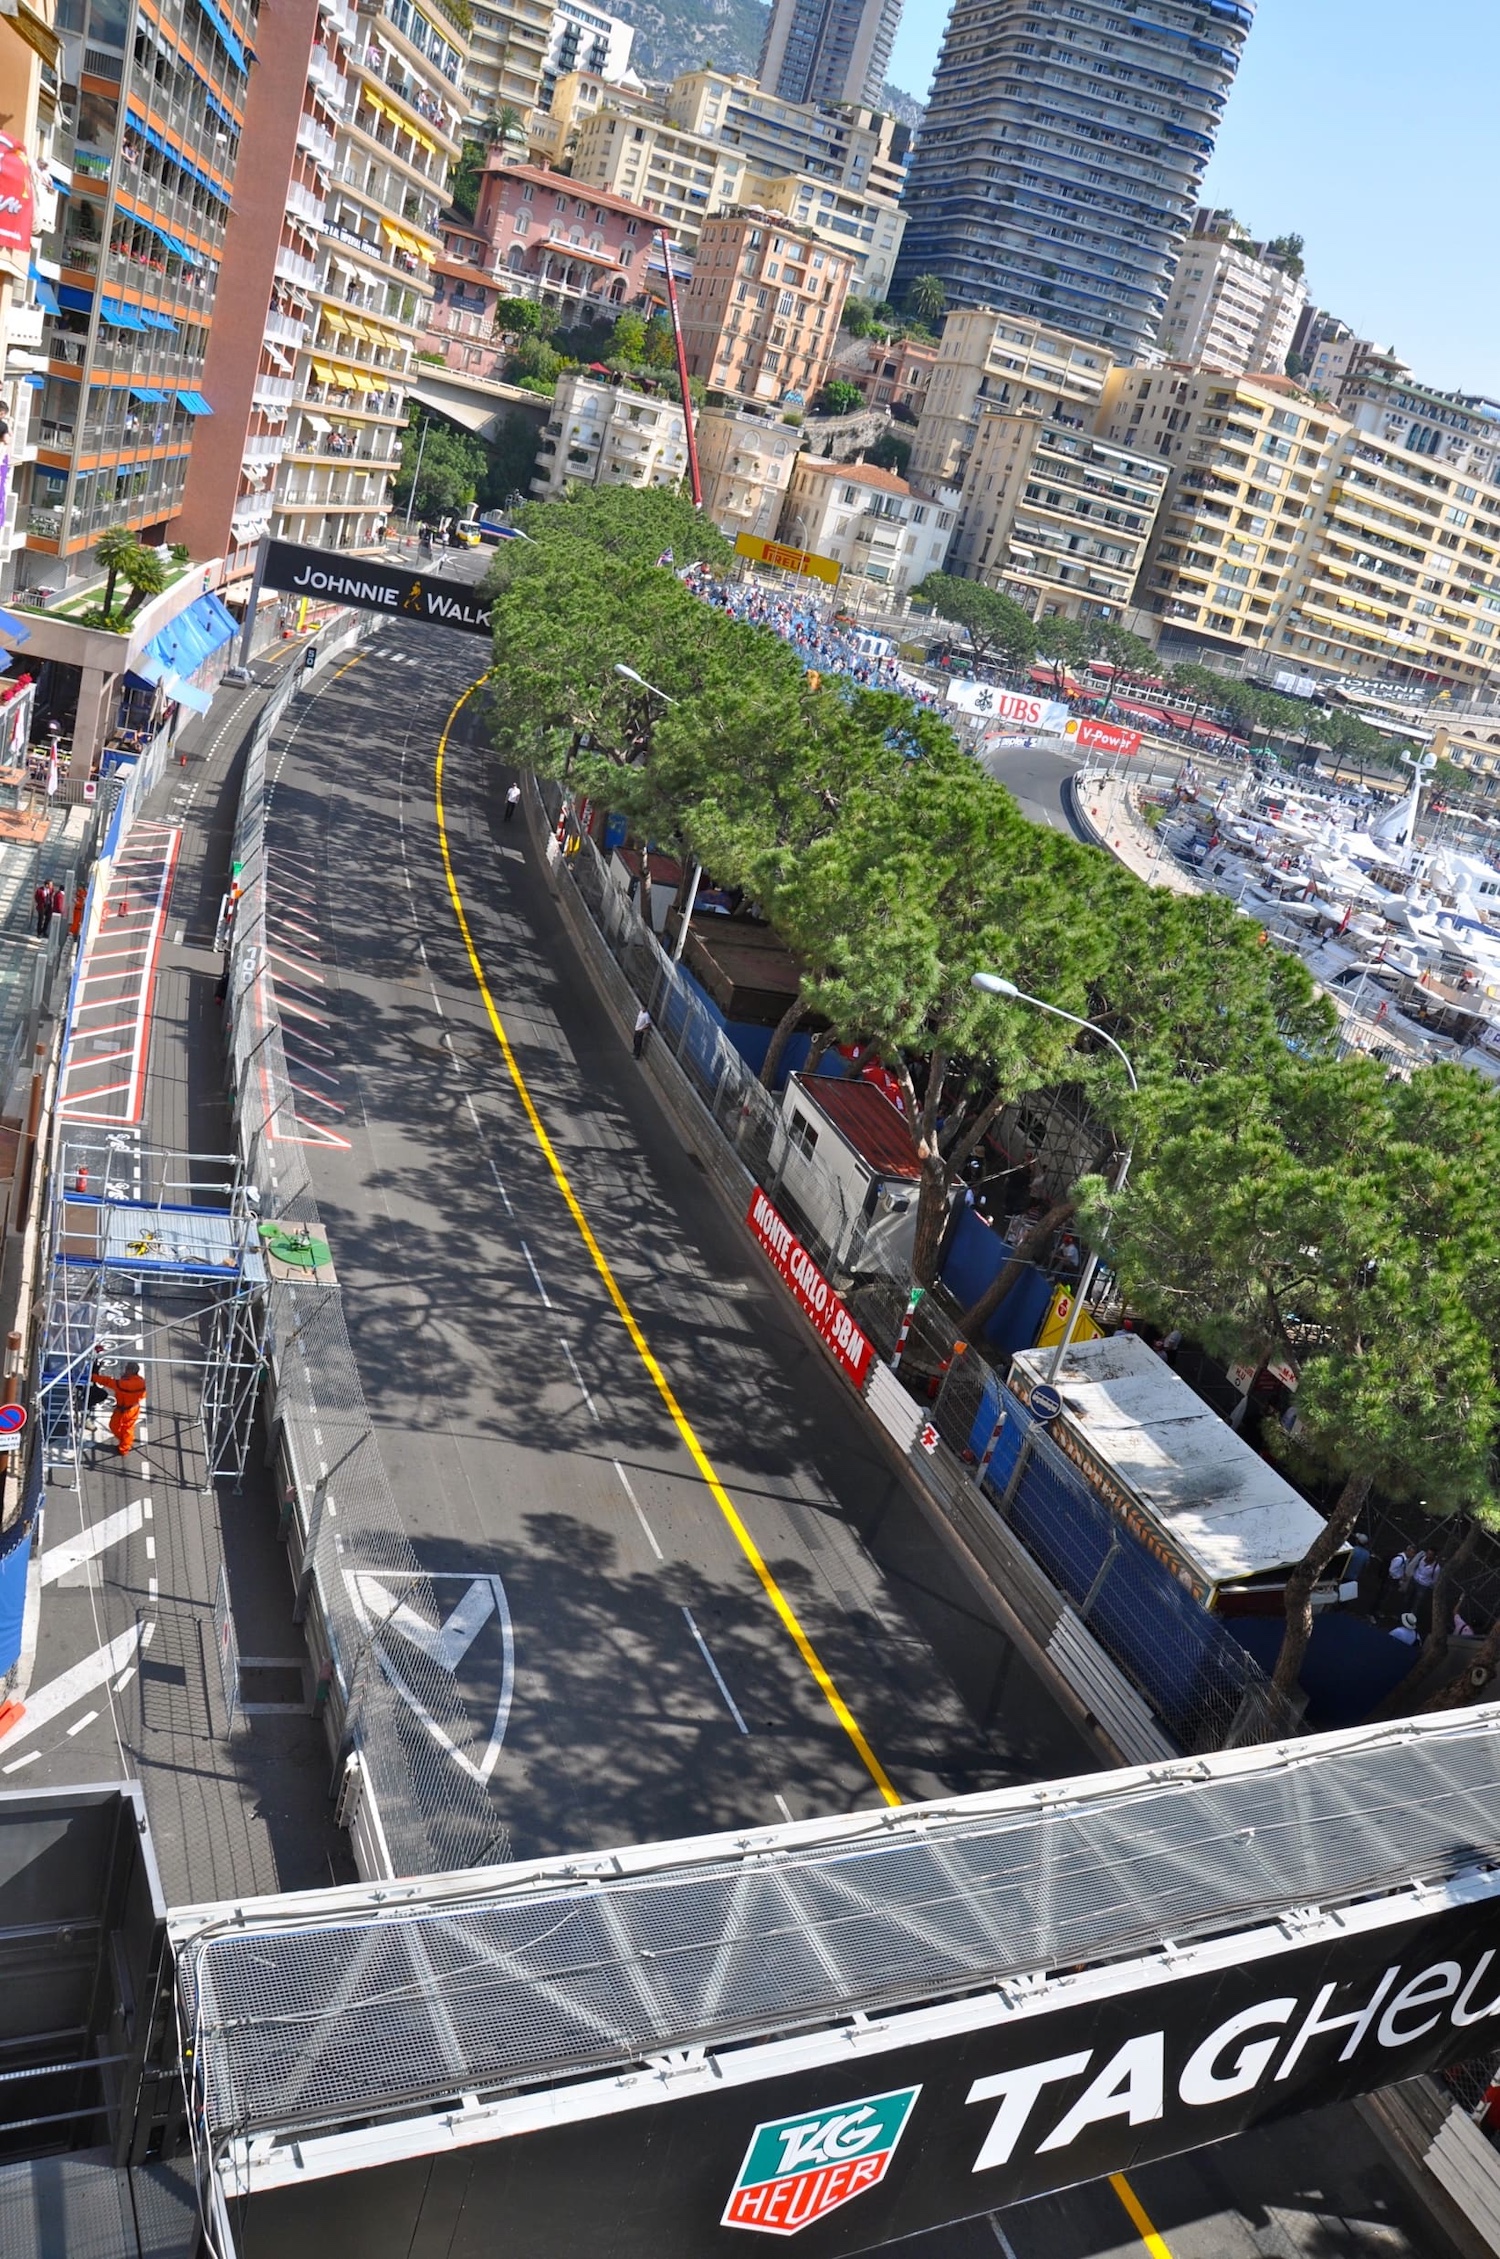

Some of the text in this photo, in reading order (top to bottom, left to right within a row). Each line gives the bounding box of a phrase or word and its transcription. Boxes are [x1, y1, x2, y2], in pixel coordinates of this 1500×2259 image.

[762, 543, 811, 573] PIRELLI
[293, 566, 400, 606] JOHNNIE
[307, 650, 315, 665] 50
[1325, 677, 1426, 695] JOHNNIE
[999, 695, 1041, 723] UBS
[1083, 726, 1132, 749] V-Power
[243, 946, 257, 984] 100
[753, 1194, 864, 1369] MONTE CARLO SBM
[964, 1997, 1299, 2173] TAG
[774, 2105, 885, 2185] TAG
[736, 2158, 880, 2225] HEUER
